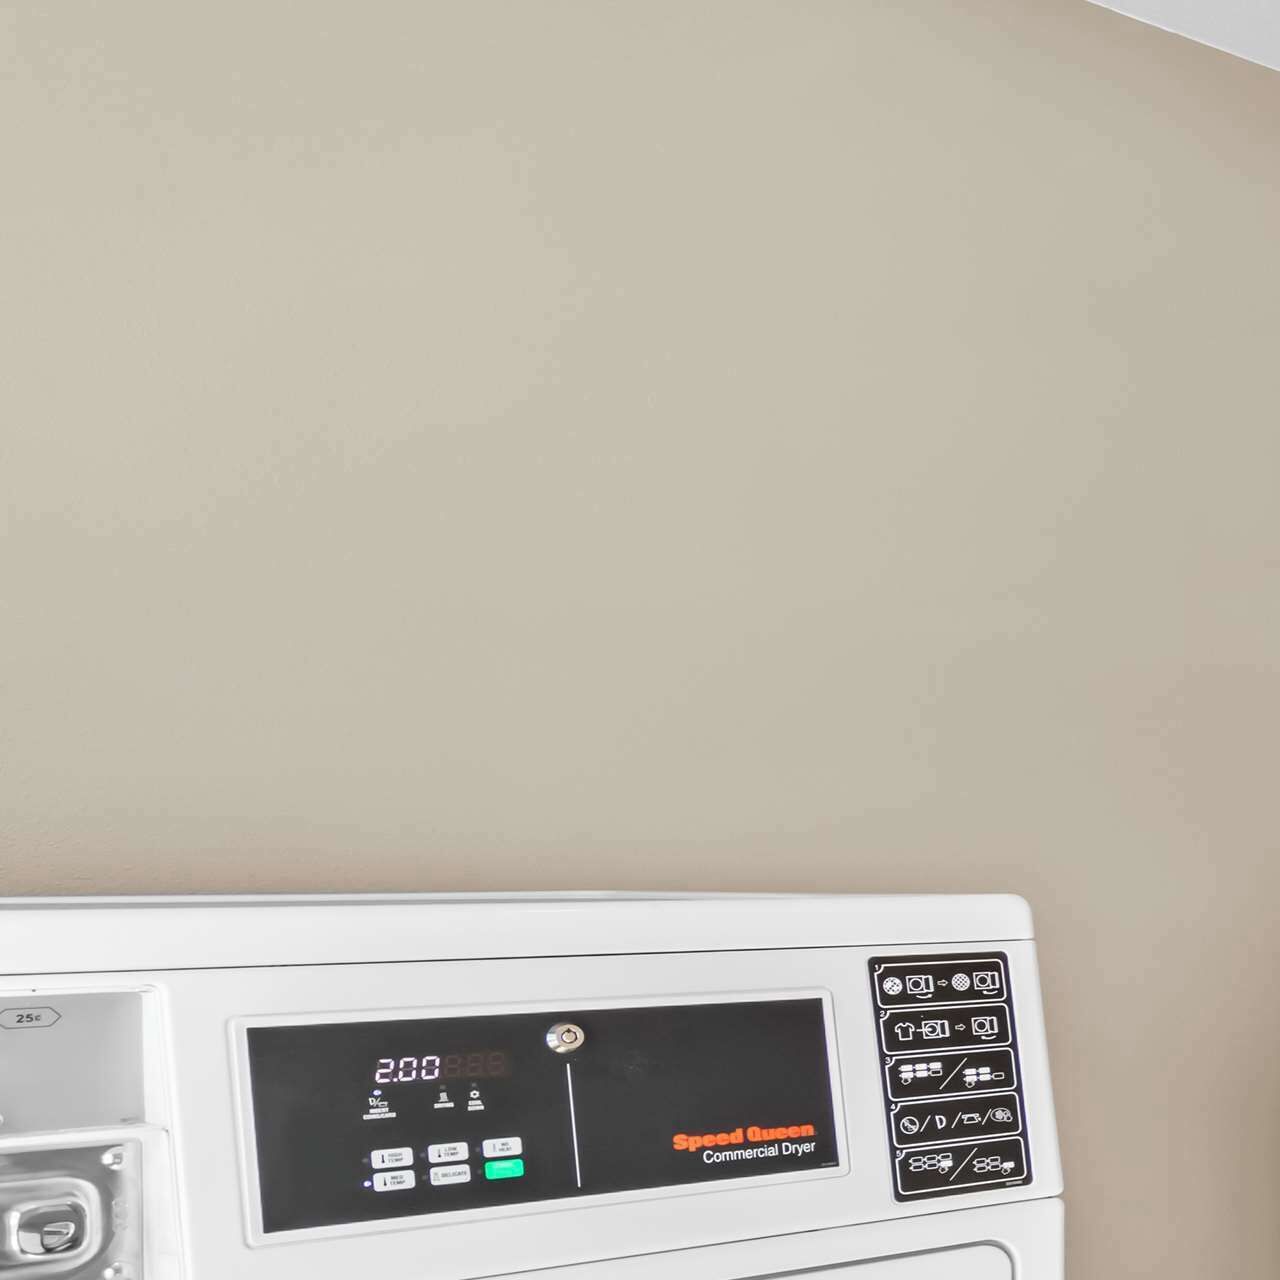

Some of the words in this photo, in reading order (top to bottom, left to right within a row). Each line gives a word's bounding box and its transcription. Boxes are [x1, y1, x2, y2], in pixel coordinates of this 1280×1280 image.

[374, 1055, 440, 1084] 2.00
[672, 1128, 744, 1151] Speed
[747, 1123, 815, 1143] Queen
[702, 1145, 779, 1164] Commercial
[782, 1141, 816, 1157] Dryer
